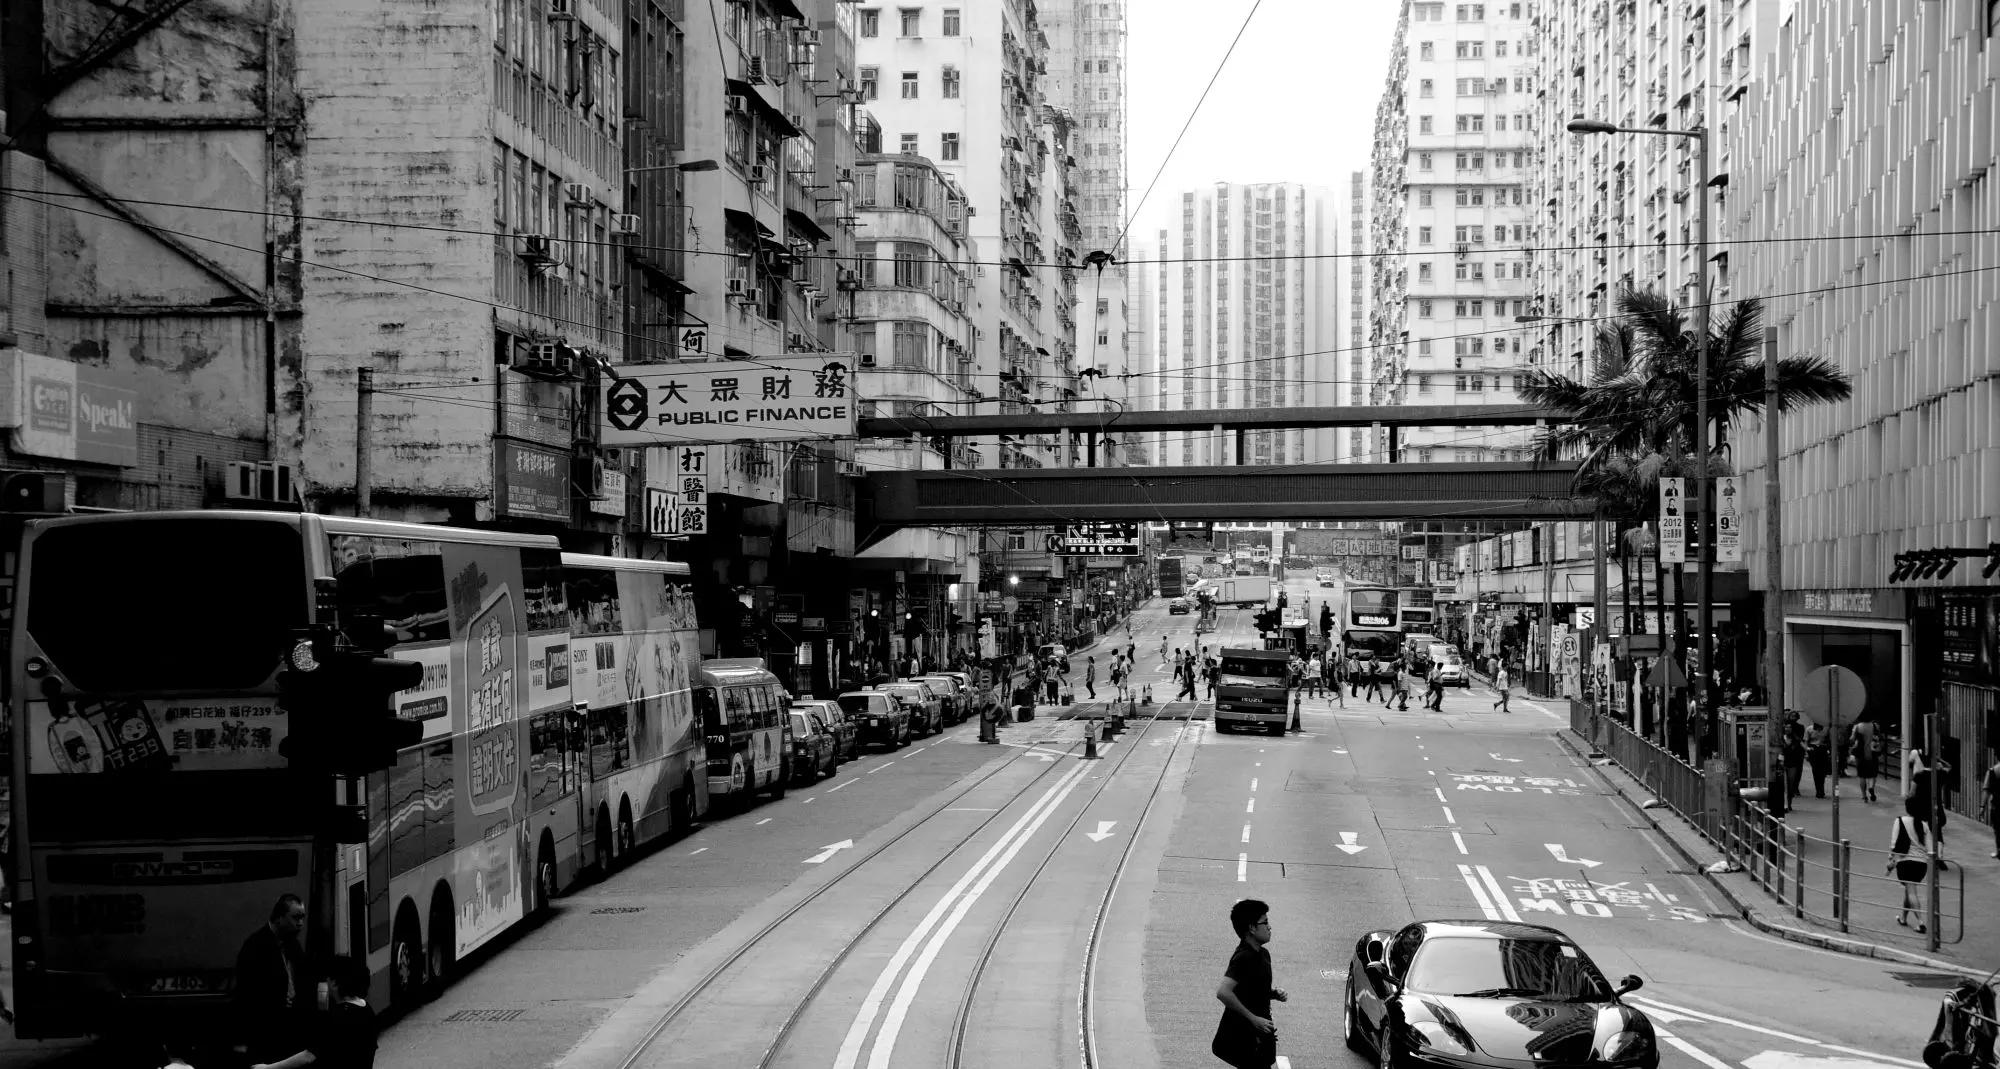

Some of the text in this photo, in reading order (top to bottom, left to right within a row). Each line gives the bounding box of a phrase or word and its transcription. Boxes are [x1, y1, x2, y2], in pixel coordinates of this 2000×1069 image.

[681, 328, 706, 355] 何
[658, 374, 846, 405] 大眾財務
[80, 392, 132, 433] Speak!
[658, 406, 847, 426] PUBLIC FINANCE
[680, 447, 706, 533] 打醫館
[1663, 518, 1682, 527] 2012
[1049, 535, 1064, 552] K
[573, 649, 588, 663] SONY
[706, 735, 725, 743] 770
[471, 728, 516, 797] 證明文件
[1456, 783, 1585, 796] SLOW
[1519, 897, 1708, 923] SLOW
